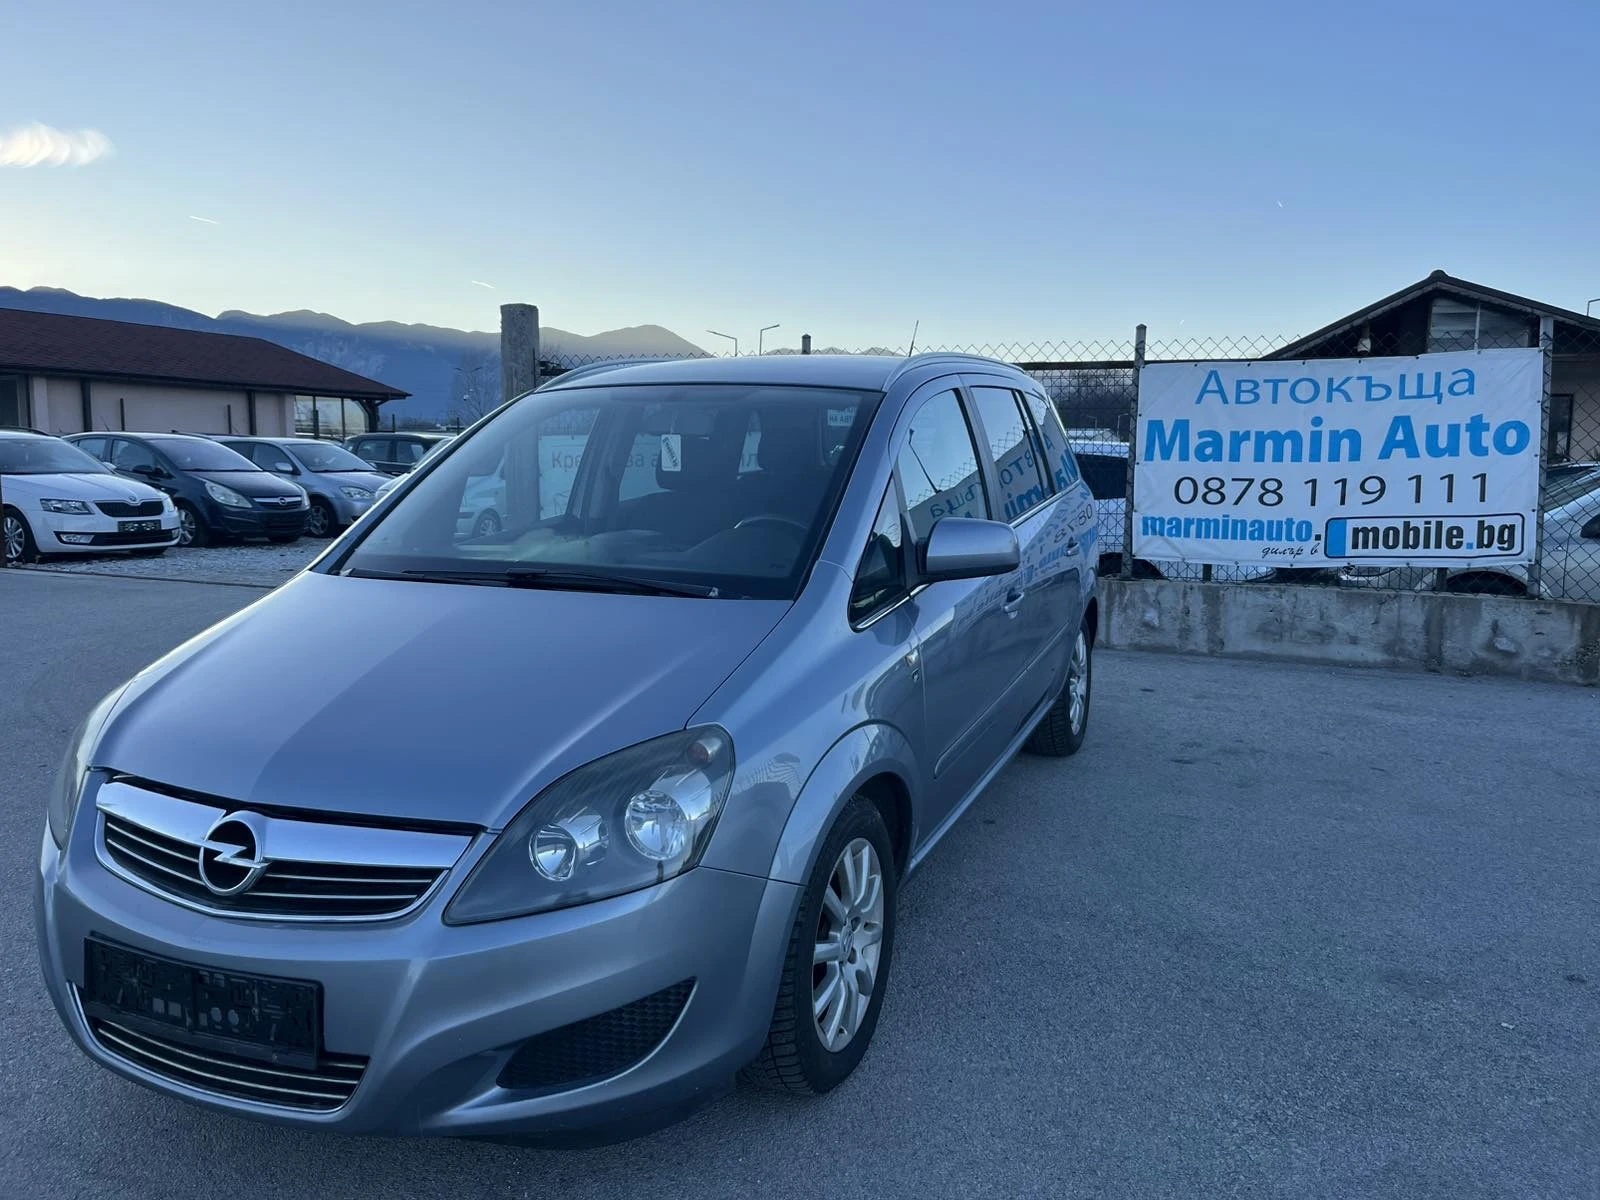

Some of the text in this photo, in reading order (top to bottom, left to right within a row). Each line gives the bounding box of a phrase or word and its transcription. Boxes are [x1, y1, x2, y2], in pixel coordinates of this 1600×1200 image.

[1195, 368, 1475, 405] Автокъща
[1144, 413, 1531, 463] Marmin Auto
[1174, 473, 1488, 507] 0878 119 111
[1351, 520, 1517, 551] mobile.bg
